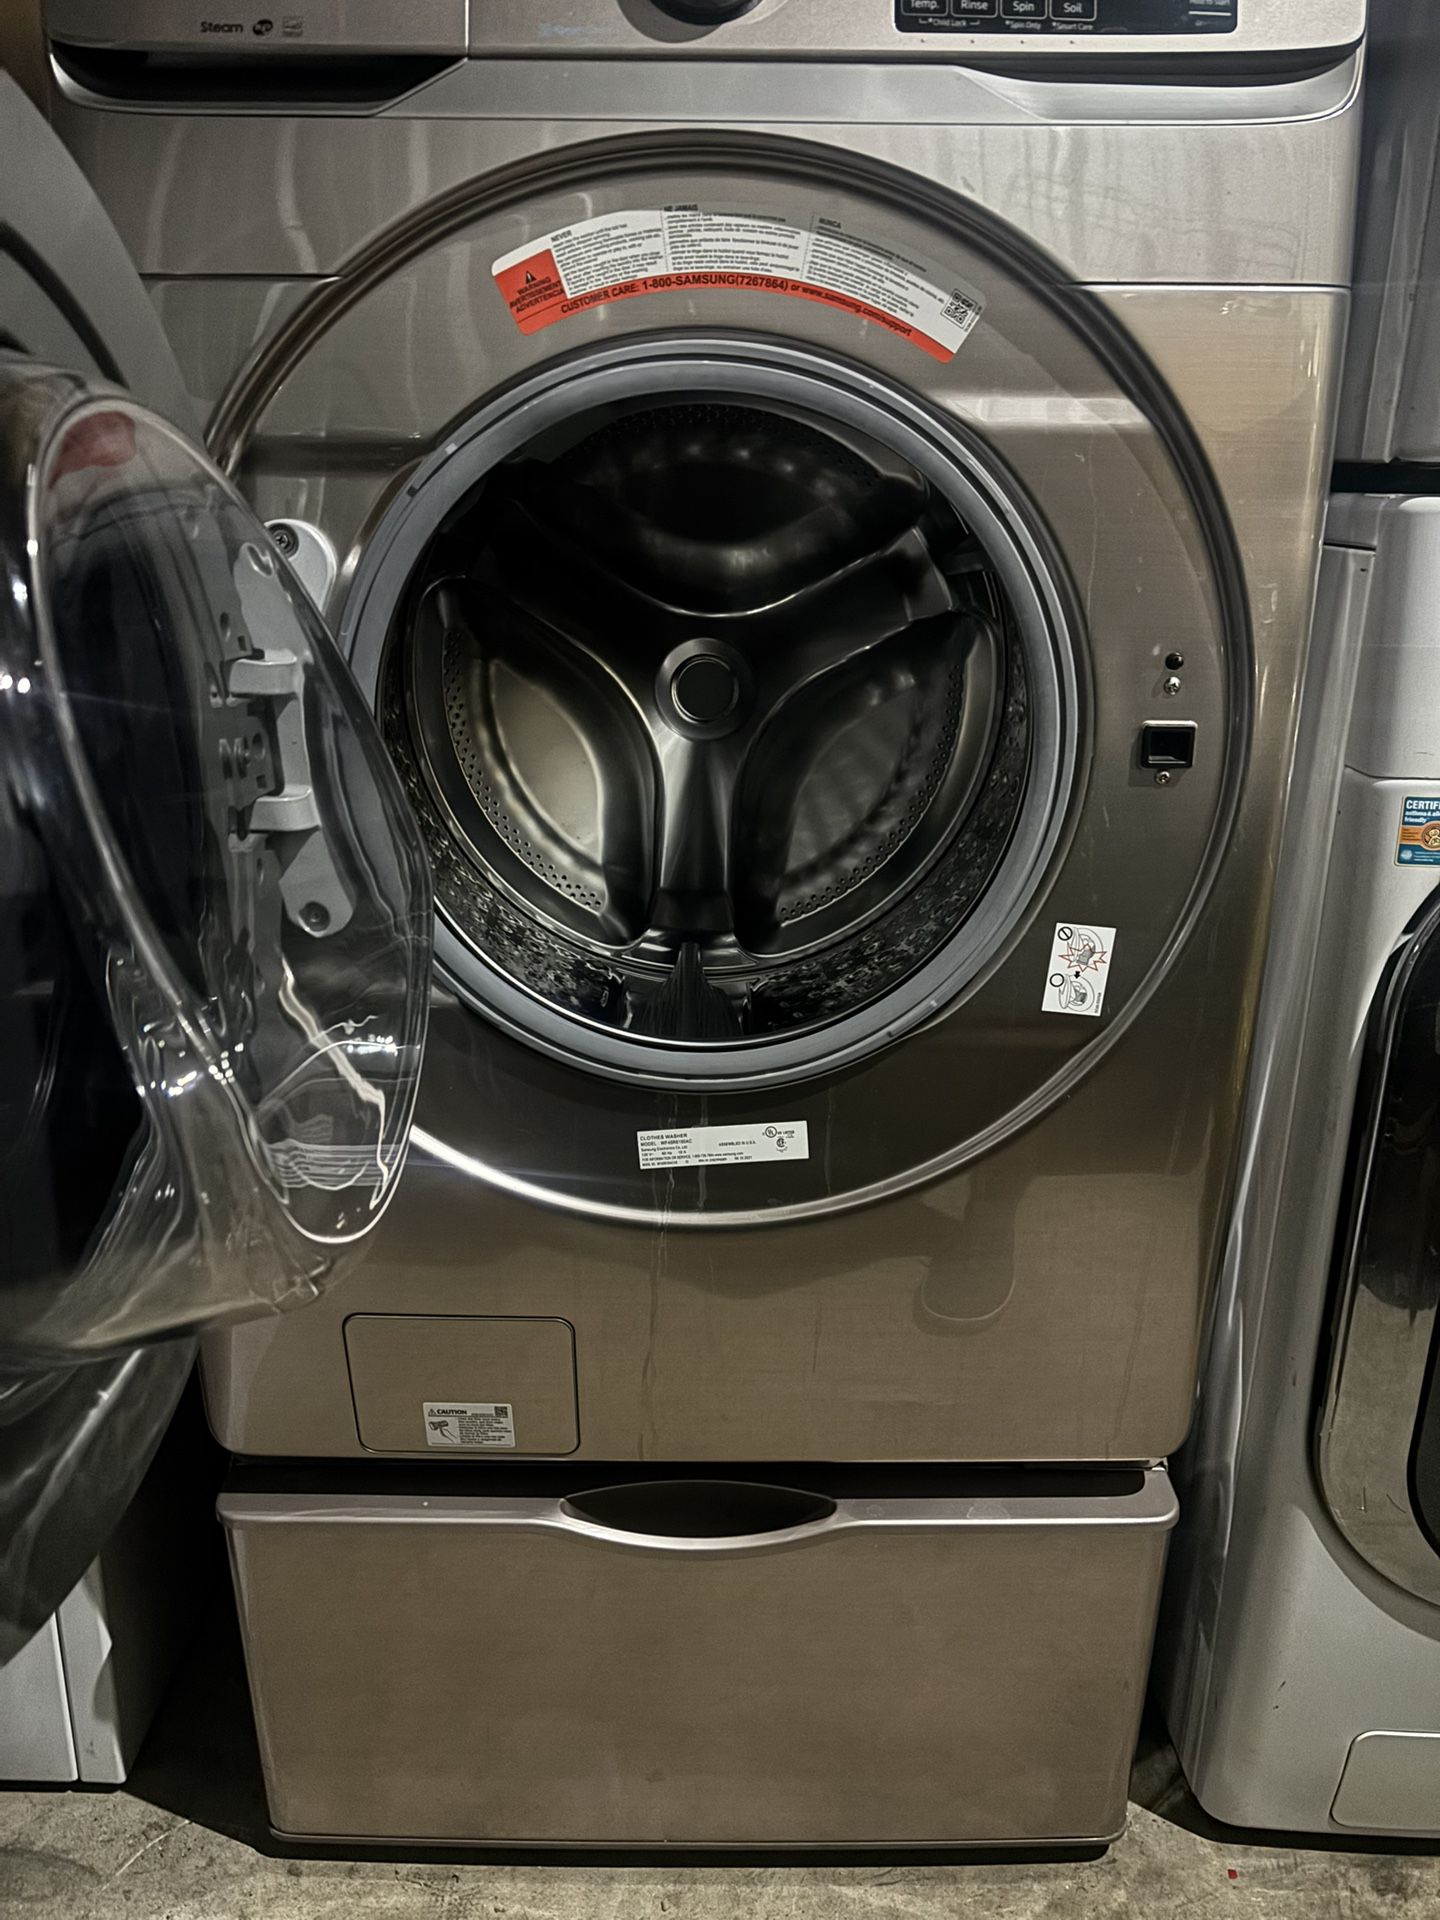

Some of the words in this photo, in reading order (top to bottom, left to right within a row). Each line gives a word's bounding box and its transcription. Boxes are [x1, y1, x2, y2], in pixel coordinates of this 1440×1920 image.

[961, 0, 988, 10] Rinse
[1013, 1, 1034, 12] Spin
[1064, 2, 1082, 13] Soil
[200, 21, 244, 33] Steam
[551, 230, 572, 242] NEVER
[560, 290, 610, 314] CUSTOMER
[612, 282, 641, 298] CARE:
[643, 274, 788, 290] 1-800-SAMSUNG(7267864)
[791, 283, 800, 292] or
